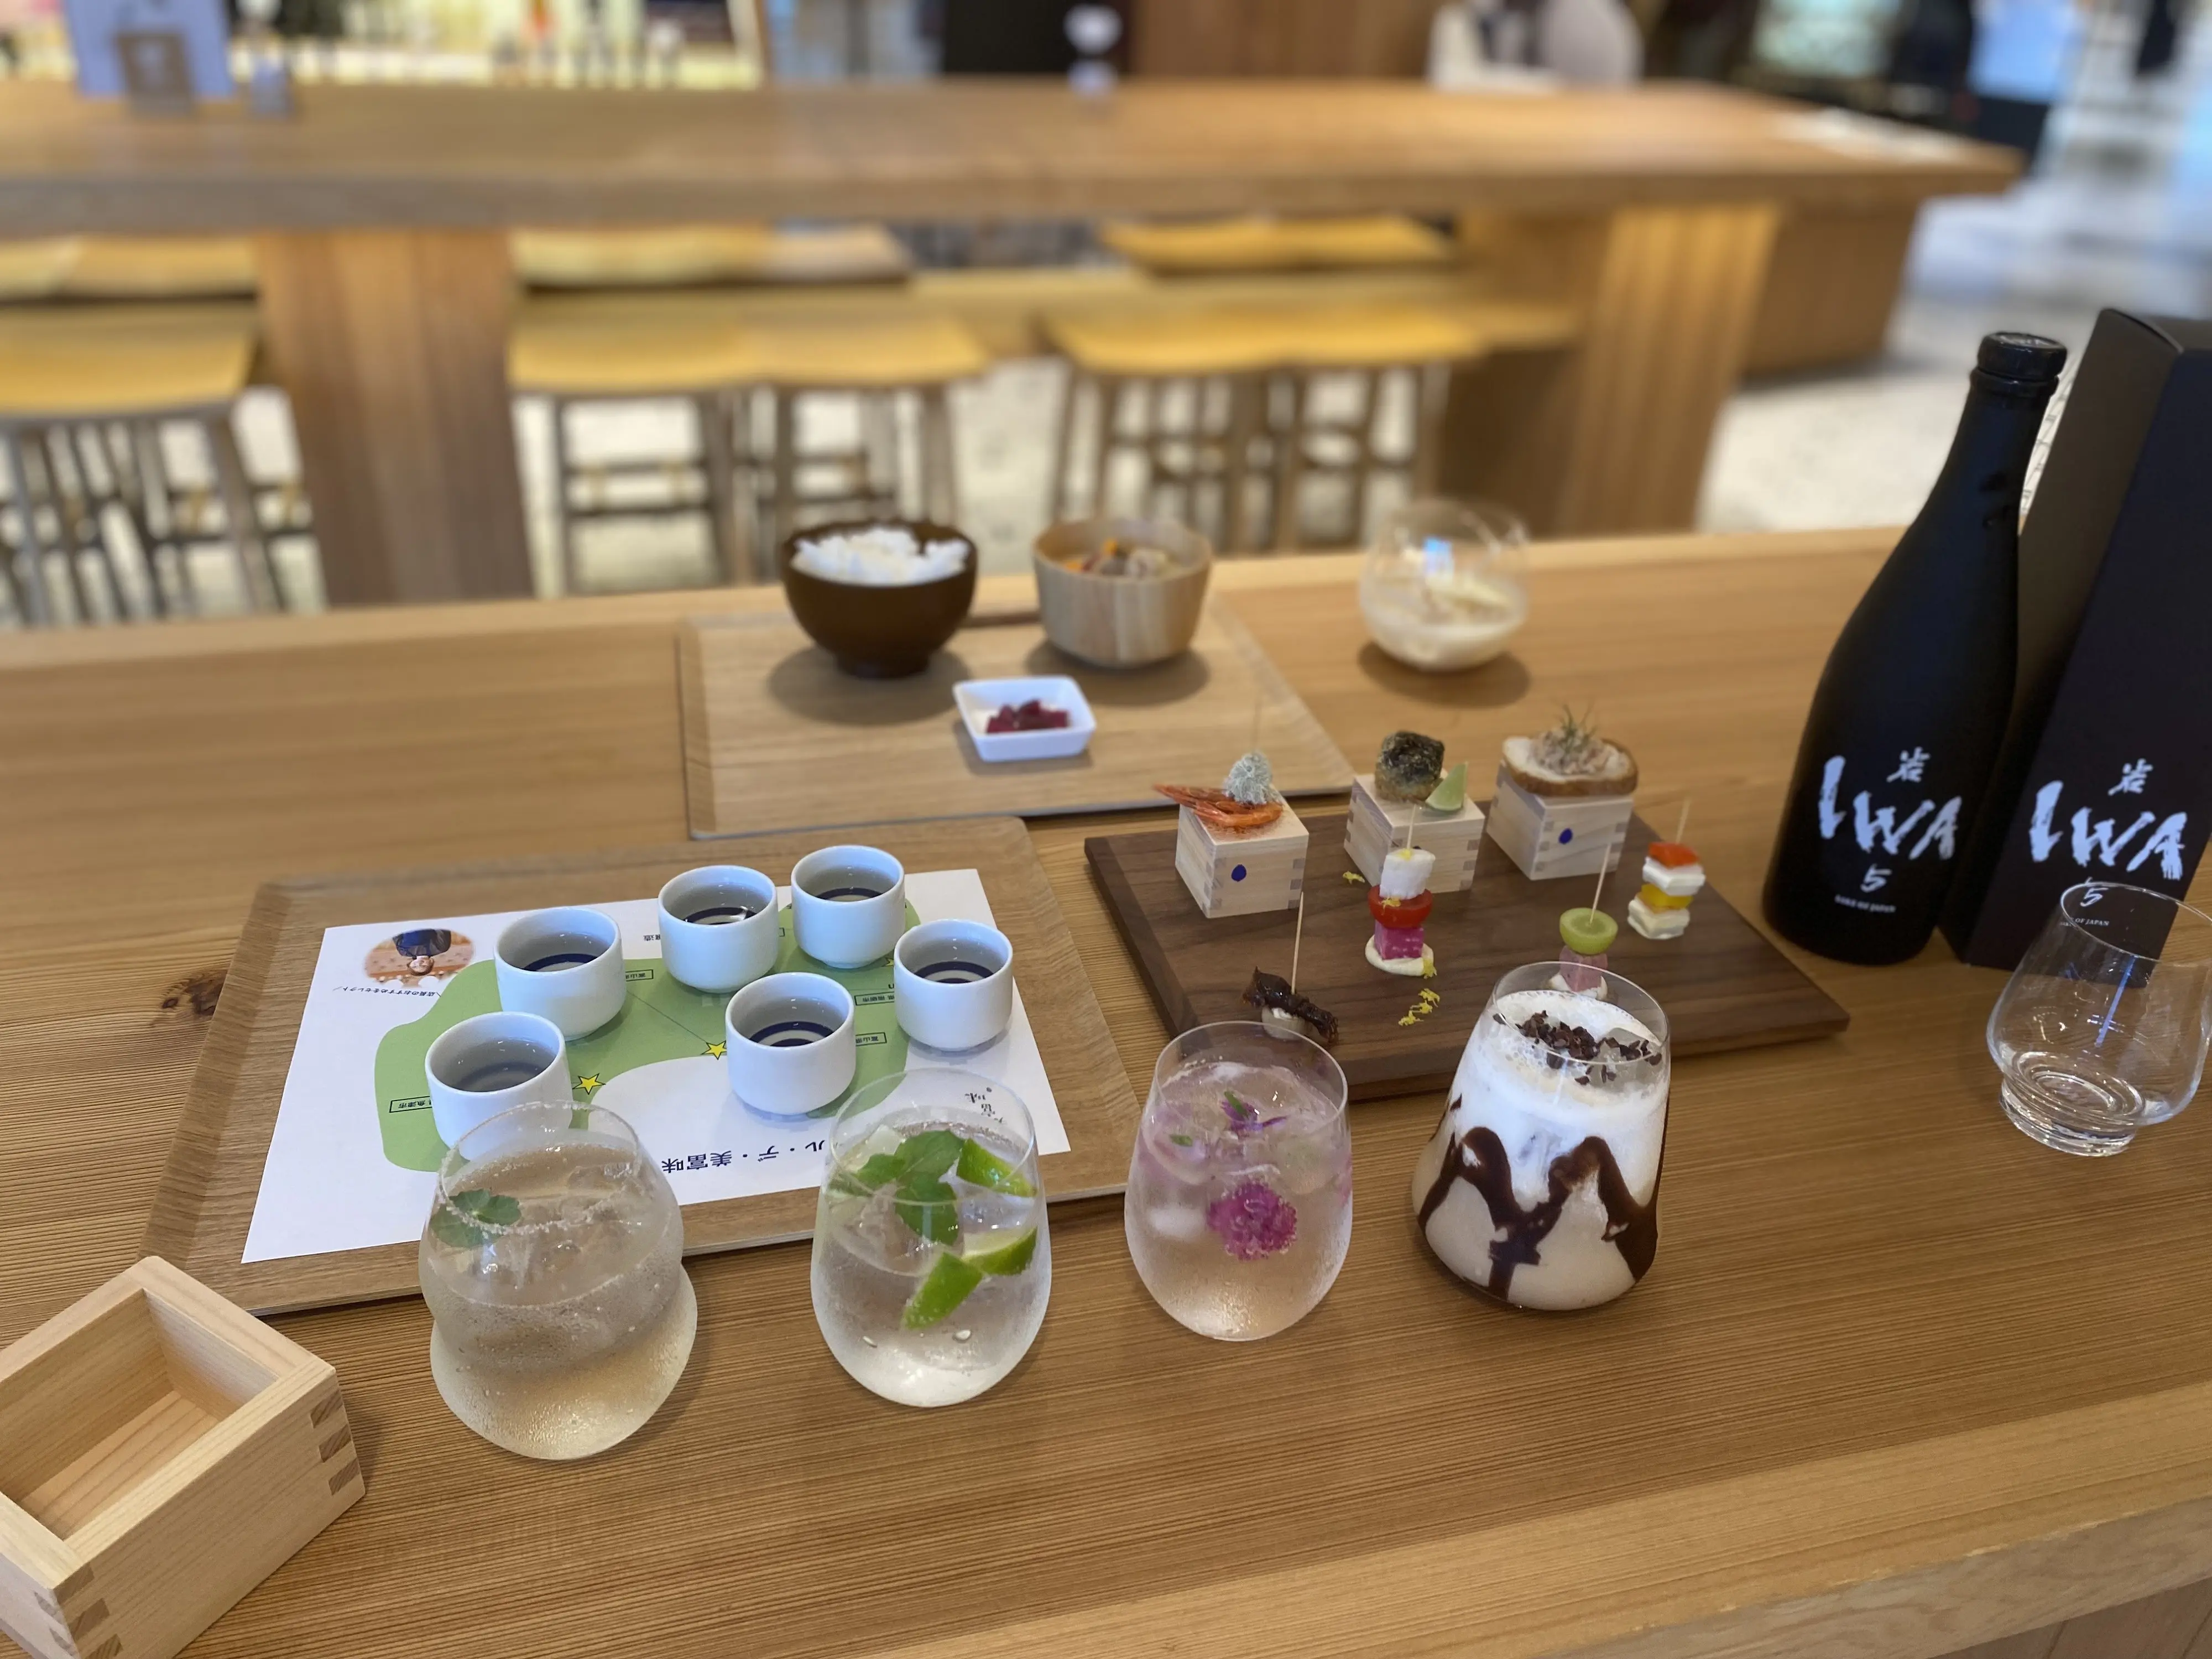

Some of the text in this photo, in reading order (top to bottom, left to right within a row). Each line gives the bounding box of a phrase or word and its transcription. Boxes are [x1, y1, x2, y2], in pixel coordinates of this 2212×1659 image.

[1818, 755, 1962, 860] IWA
[2030, 780, 2188, 881] IWA
[1861, 863, 1891, 893] 5
[2079, 877, 2109, 907] 5
